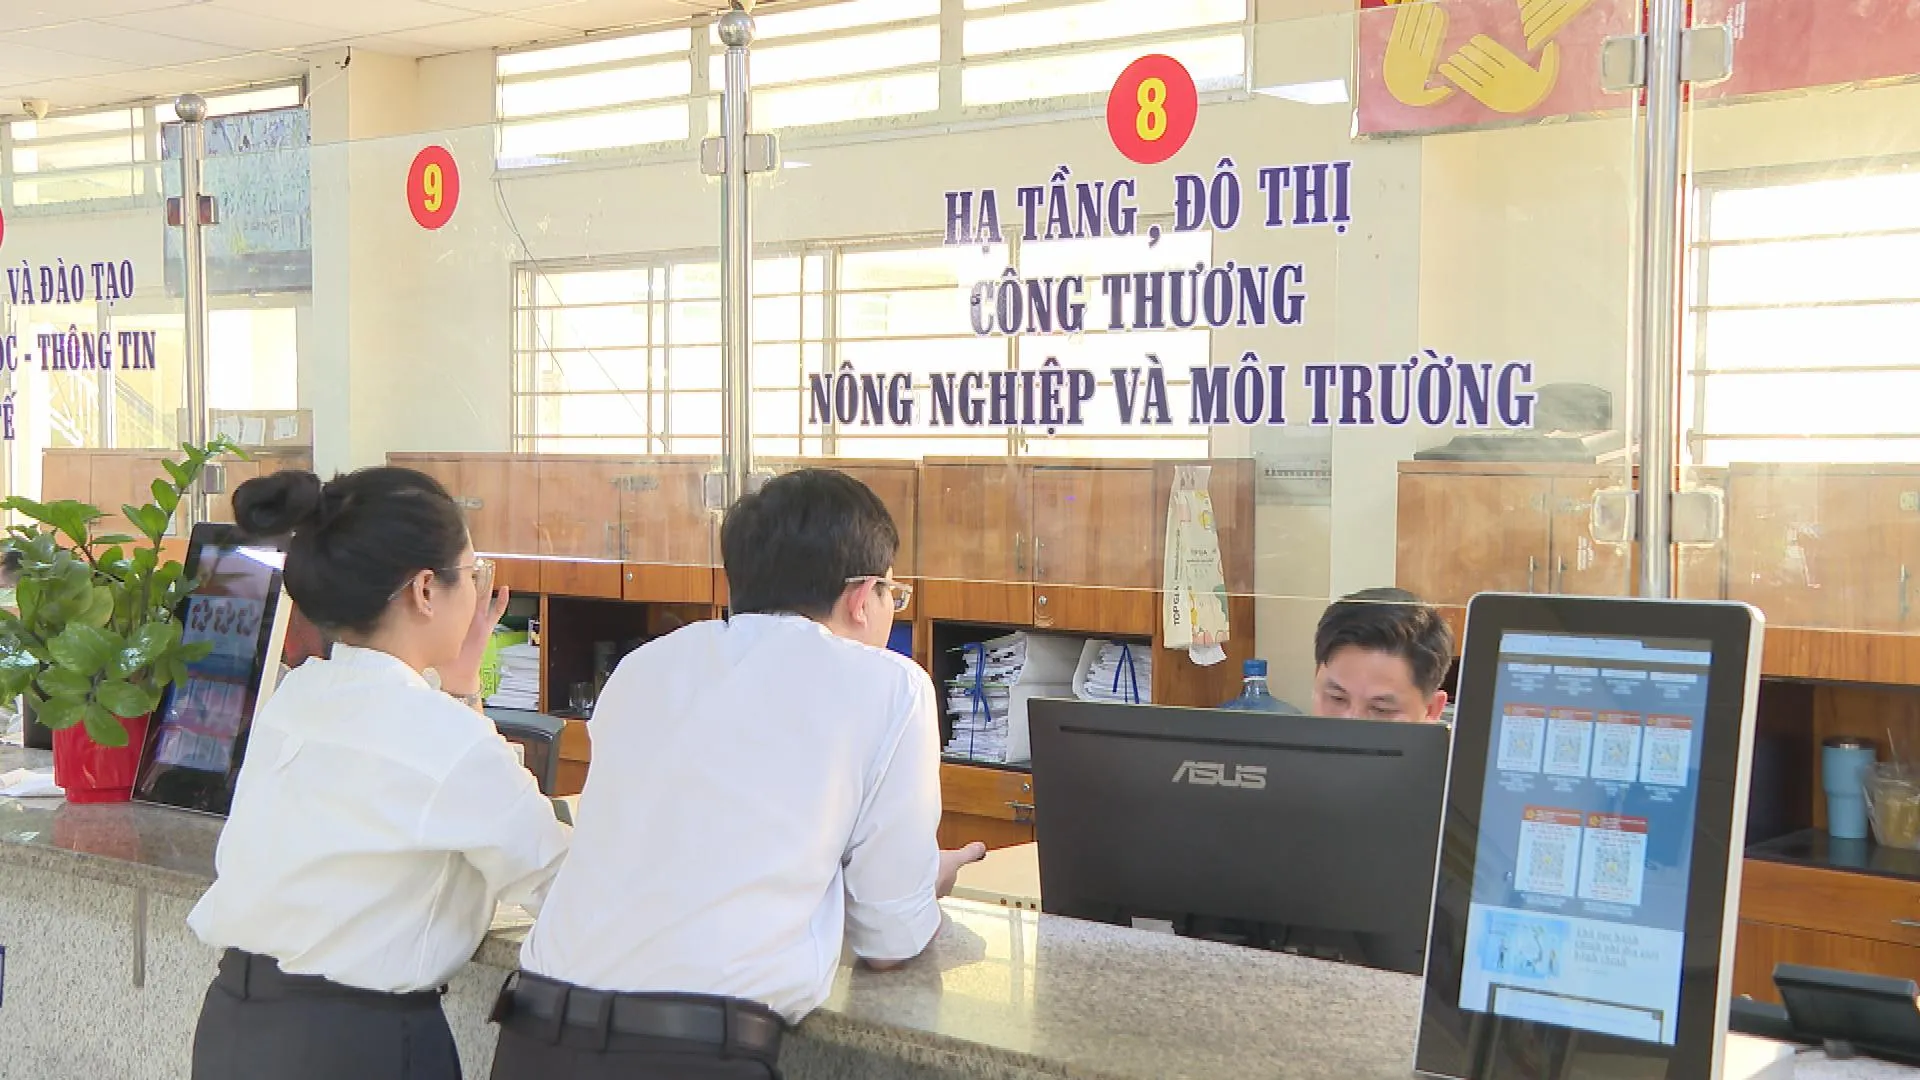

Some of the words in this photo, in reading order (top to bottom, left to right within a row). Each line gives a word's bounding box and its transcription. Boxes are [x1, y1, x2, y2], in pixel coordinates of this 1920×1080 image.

[1135, 76, 1167, 142] 8
[422, 162, 444, 213] 9
[944, 188, 1002, 253] HẠ
[1017, 165, 1138, 242] TẦNG
[1173, 157, 1240, 231] ĐÔ
[1259, 160, 1352, 234] THỊ
[6, 259, 36, 305] VÀ
[39, 257, 86, 304] ĐÀO
[91, 259, 135, 307] TẠO
[969, 267, 1087, 336] CÔNG
[1101, 260, 1306, 330] THƯƠNG
[37, 323, 113, 371] THÔNG
[117, 331, 156, 371] TIN
[808, 361, 914, 426] NÔNG
[930, 357, 1096, 436] NGHIỆP
[1110, 355, 1173, 425] VÀ
[1190, 350, 1287, 426] MÔI
[1304, 348, 1536, 428] TRƯỜNG
[1171, 760, 1268, 790] ASUS
